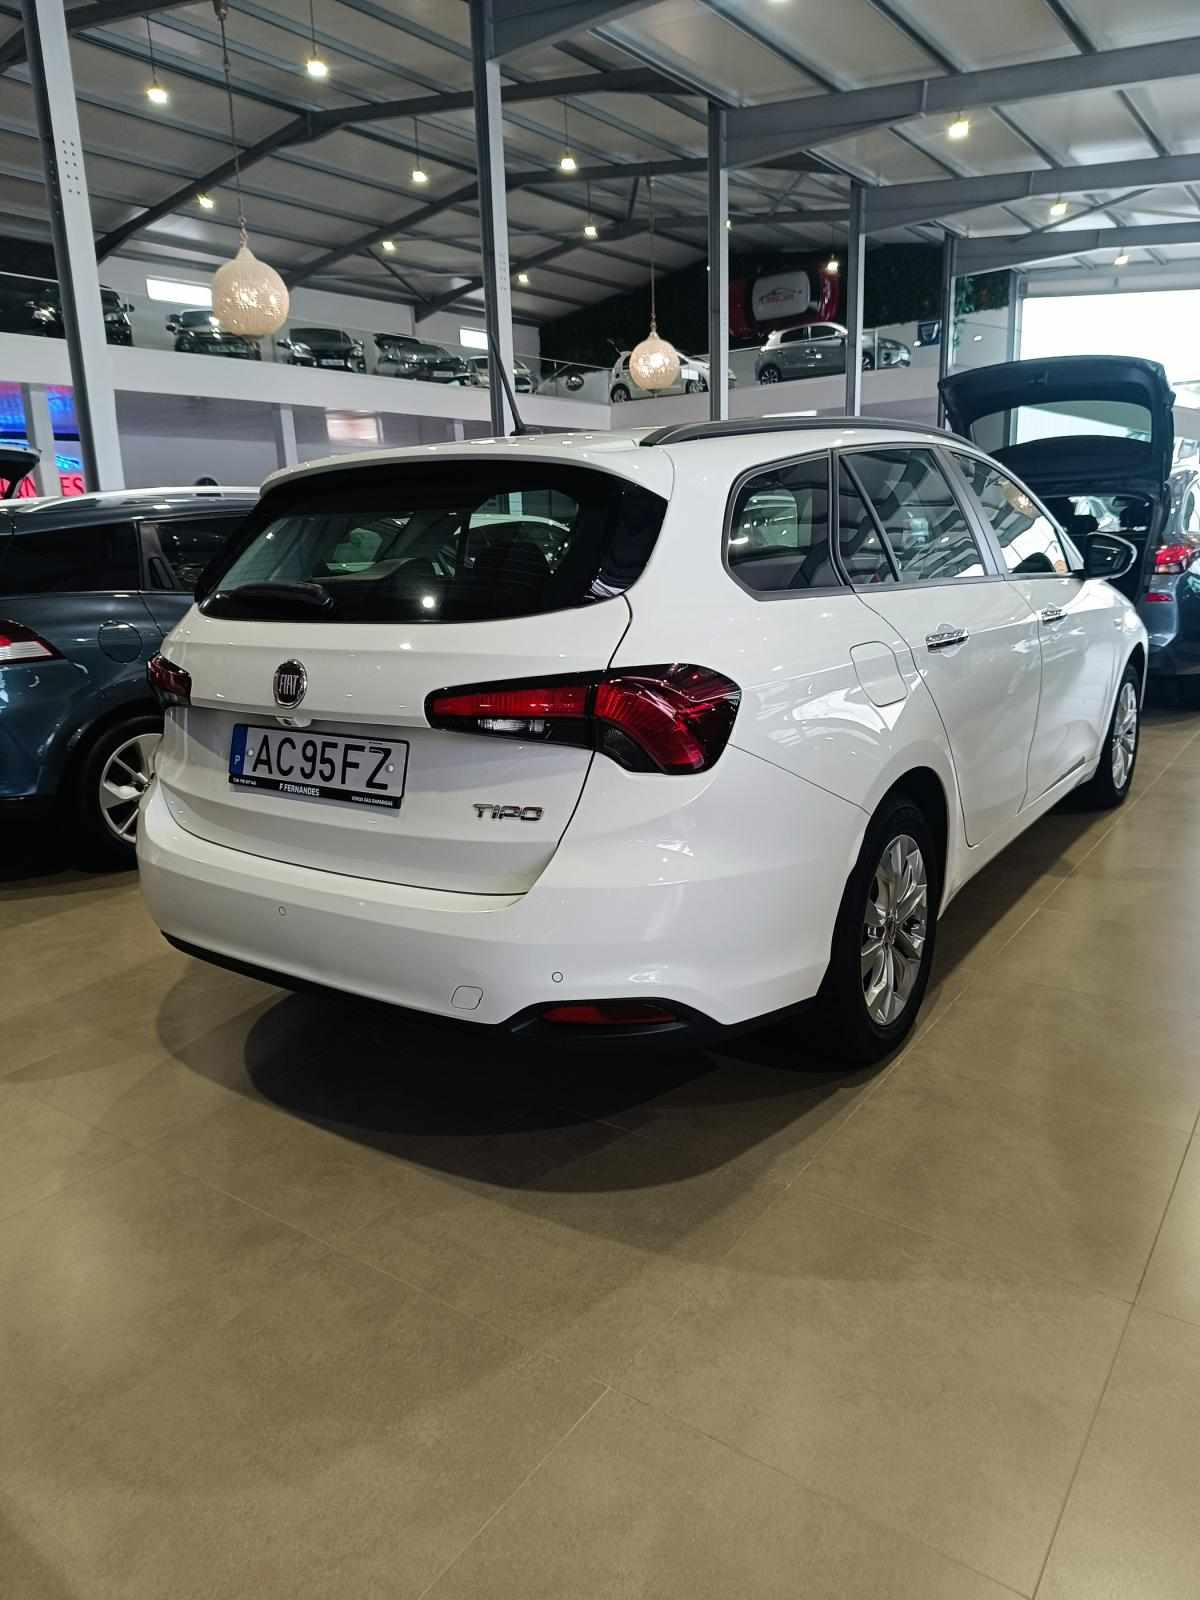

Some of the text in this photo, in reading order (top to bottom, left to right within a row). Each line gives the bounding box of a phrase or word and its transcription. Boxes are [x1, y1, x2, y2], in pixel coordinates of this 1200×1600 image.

[280, 673, 299, 695] FIAT
[234, 754, 241, 765] P
[252, 734, 392, 791] AC95FZ
[472, 803, 543, 821] TIPO
